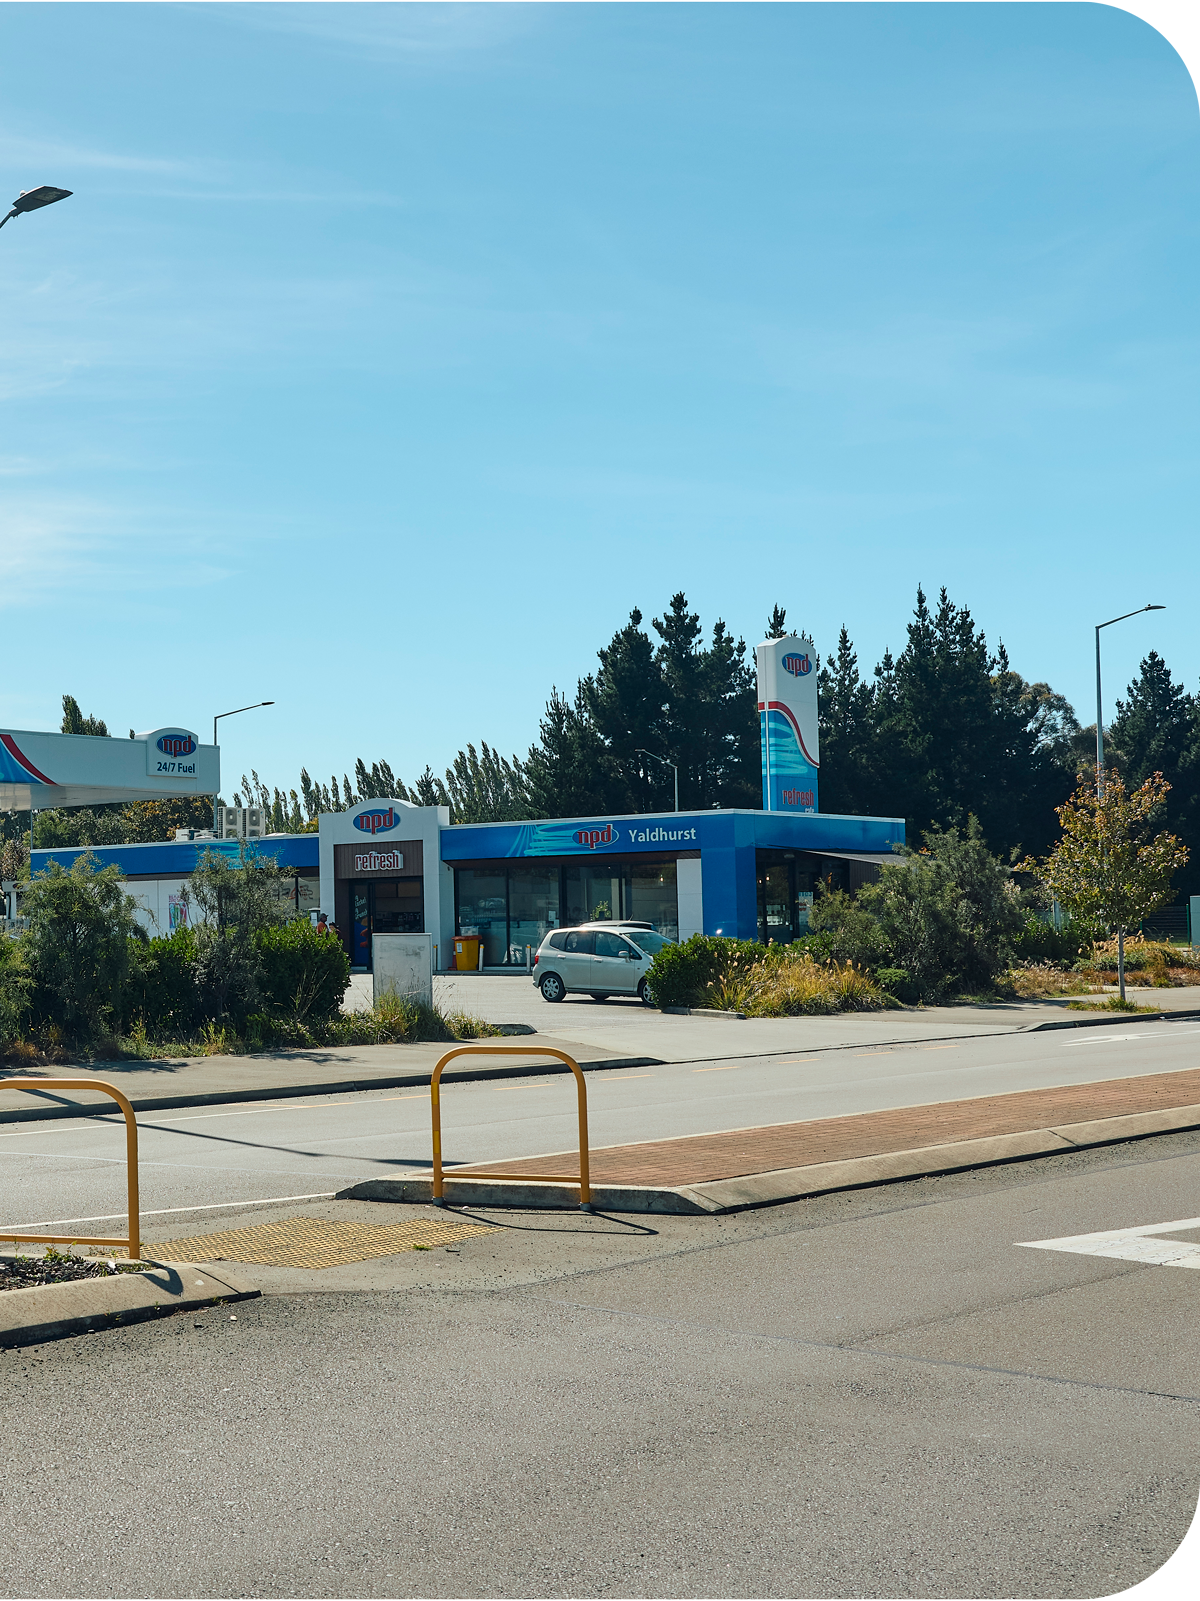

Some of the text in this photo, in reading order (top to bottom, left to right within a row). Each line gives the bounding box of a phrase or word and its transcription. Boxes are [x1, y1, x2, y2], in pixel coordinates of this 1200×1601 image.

[786, 653, 809, 677] npd
[162, 735, 192, 758] npd
[156, 761, 196, 774] 24/7 Fuel
[782, 787, 815, 806] refresh
[358, 806, 395, 835] npd
[577, 824, 697, 849] npd Yaldhurst
[355, 849, 403, 871] refresh
